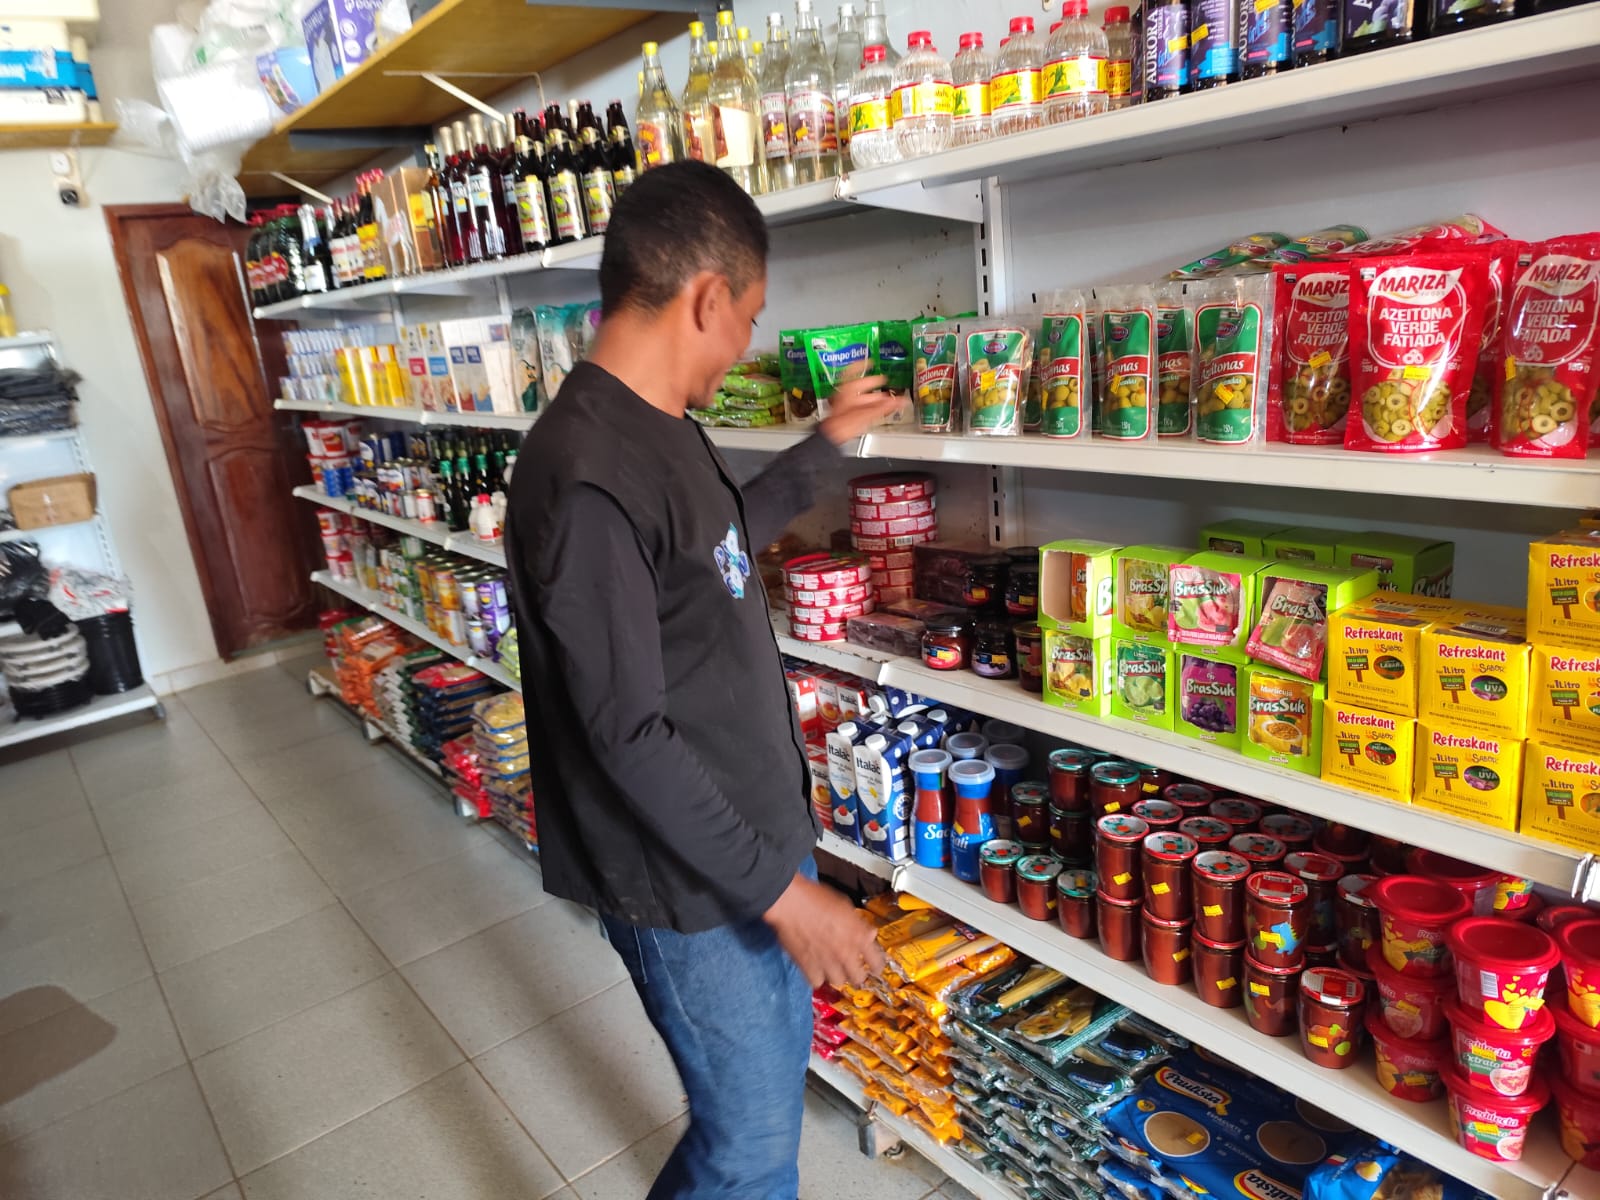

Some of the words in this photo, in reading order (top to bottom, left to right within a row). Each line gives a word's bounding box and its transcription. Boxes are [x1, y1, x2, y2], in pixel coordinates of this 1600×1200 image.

[1146, 9, 1158, 84] AURORA
[1528, 264, 1591, 283] MARIZA
[1298, 280, 1349, 298] MARIZ
[1378, 274, 1447, 293] MARIZA
[1379, 307, 1453, 320] AZEITONA
[1525, 300, 1584, 313] AZEITONA
[1299, 311, 1349, 322] AZEITON
[1528, 314, 1570, 328] VERDE
[1307, 322, 1345, 334] VERDE
[1391, 321, 1439, 334] VERDE
[1517, 328, 1571, 342] FATIADA
[1298, 333, 1345, 346] FATIADA
[1383, 332, 1446, 347] FATIADA
[822, 351, 850, 363] Campo
[1130, 578, 1168, 595] BrasSu
[1345, 626, 1404, 642] Refreskant
[1438, 644, 1506, 662] Refreskant
[1119, 660, 1166, 674] BrasSuk
[1186, 678, 1236, 697] BrasSuk
[1484, 684, 1505, 692] UVA
[1250, 696, 1305, 713] BrasSuk
[1337, 711, 1395, 731] Refreskant
[1432, 732, 1499, 753] Refreskant
[828, 744, 850, 762] Italac
[856, 757, 880, 775] Italac
[1478, 771, 1498, 780] UVA
[1165, 1072, 1221, 1104] Paulista
